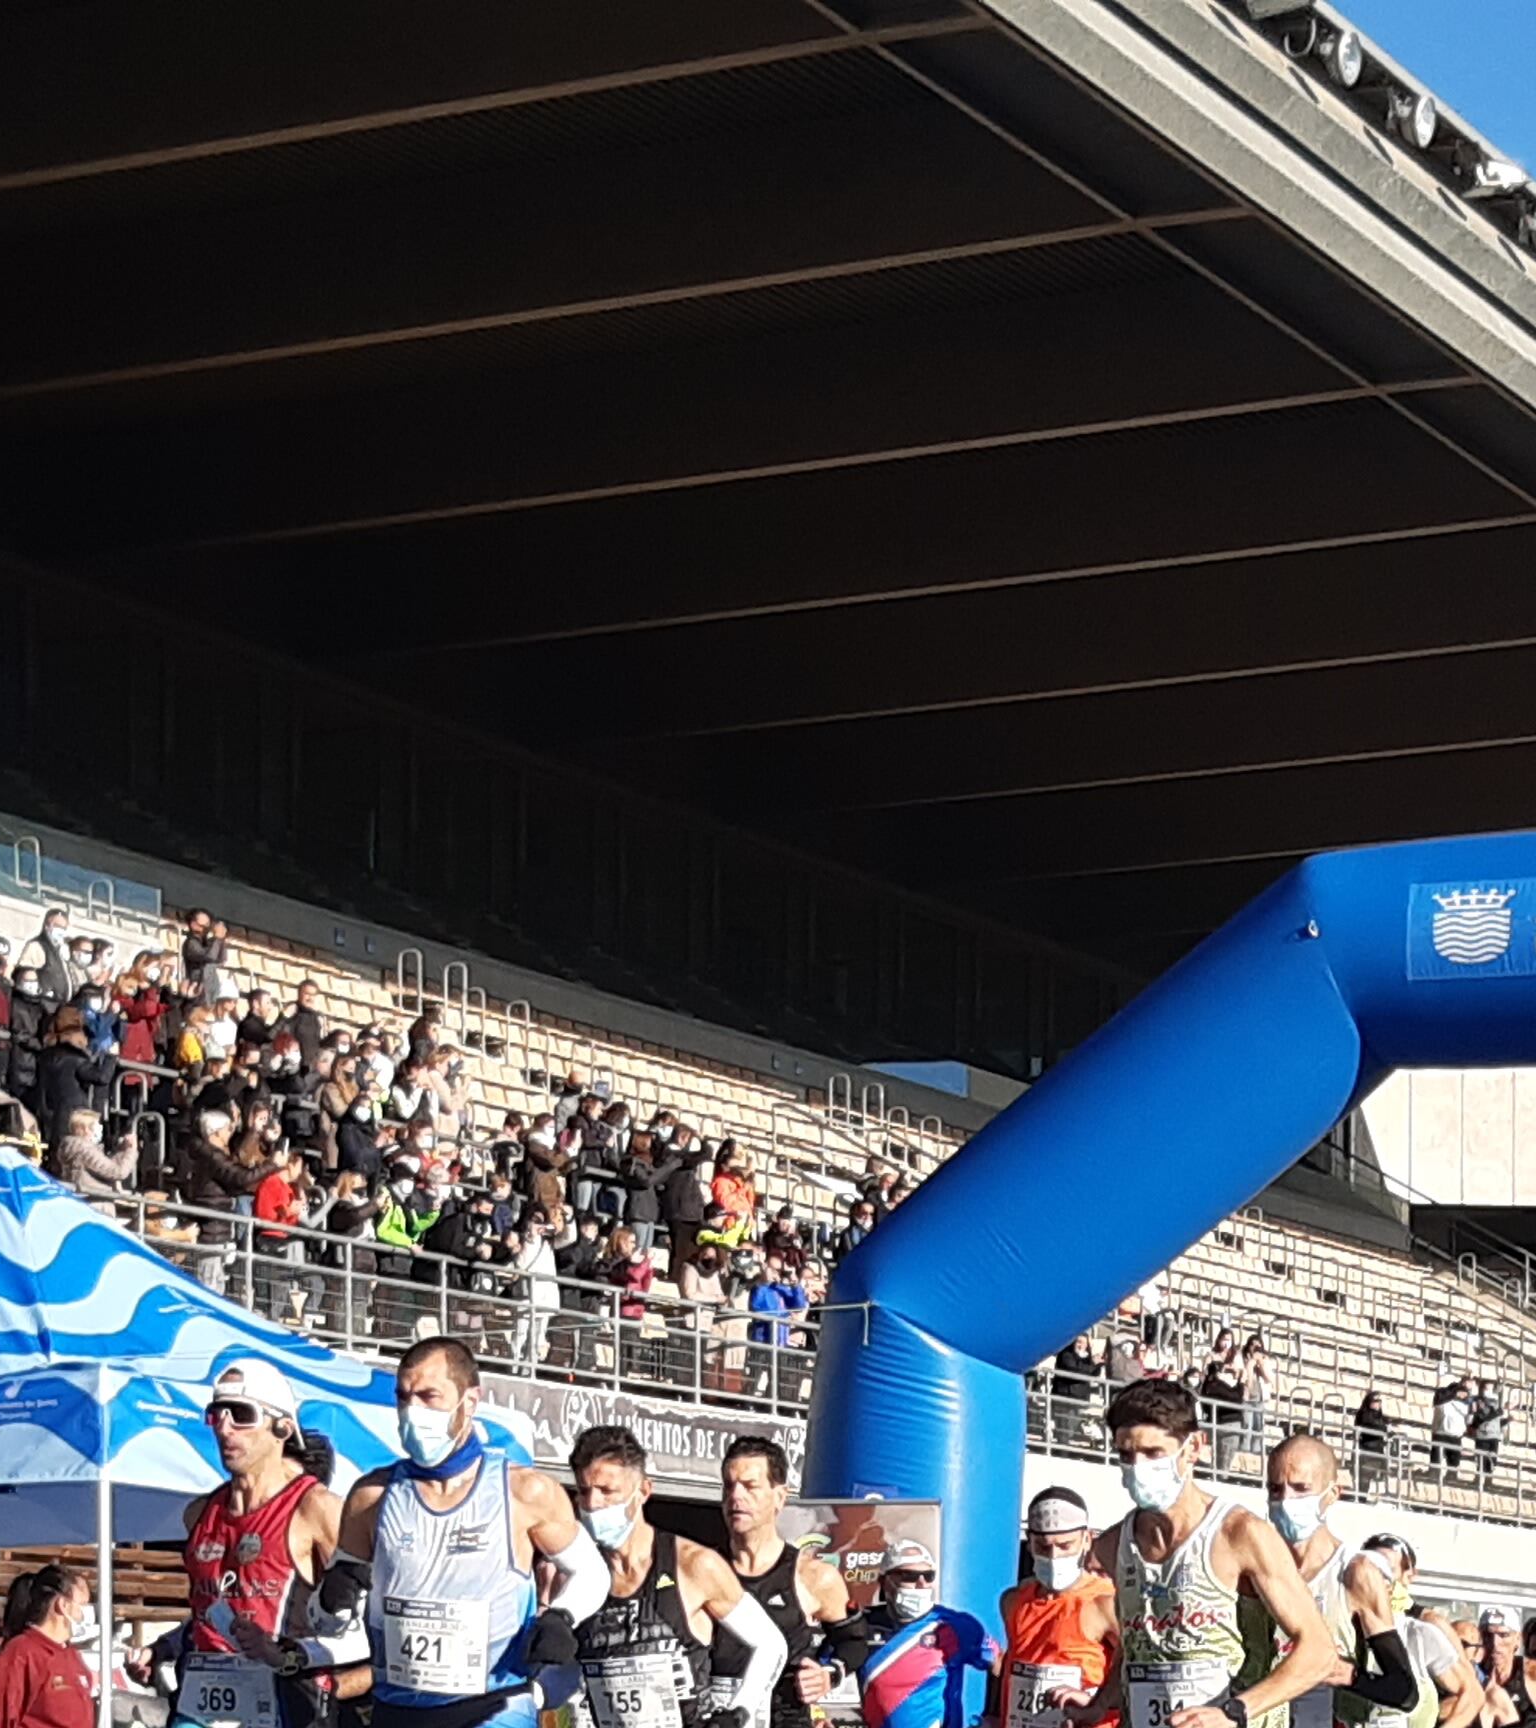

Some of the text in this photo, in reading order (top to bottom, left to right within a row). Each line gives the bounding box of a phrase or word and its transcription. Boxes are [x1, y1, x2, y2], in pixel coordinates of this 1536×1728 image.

[400, 1633, 443, 1663] 421
[197, 1687, 237, 1712] 369
[604, 1689, 643, 1714] 755
